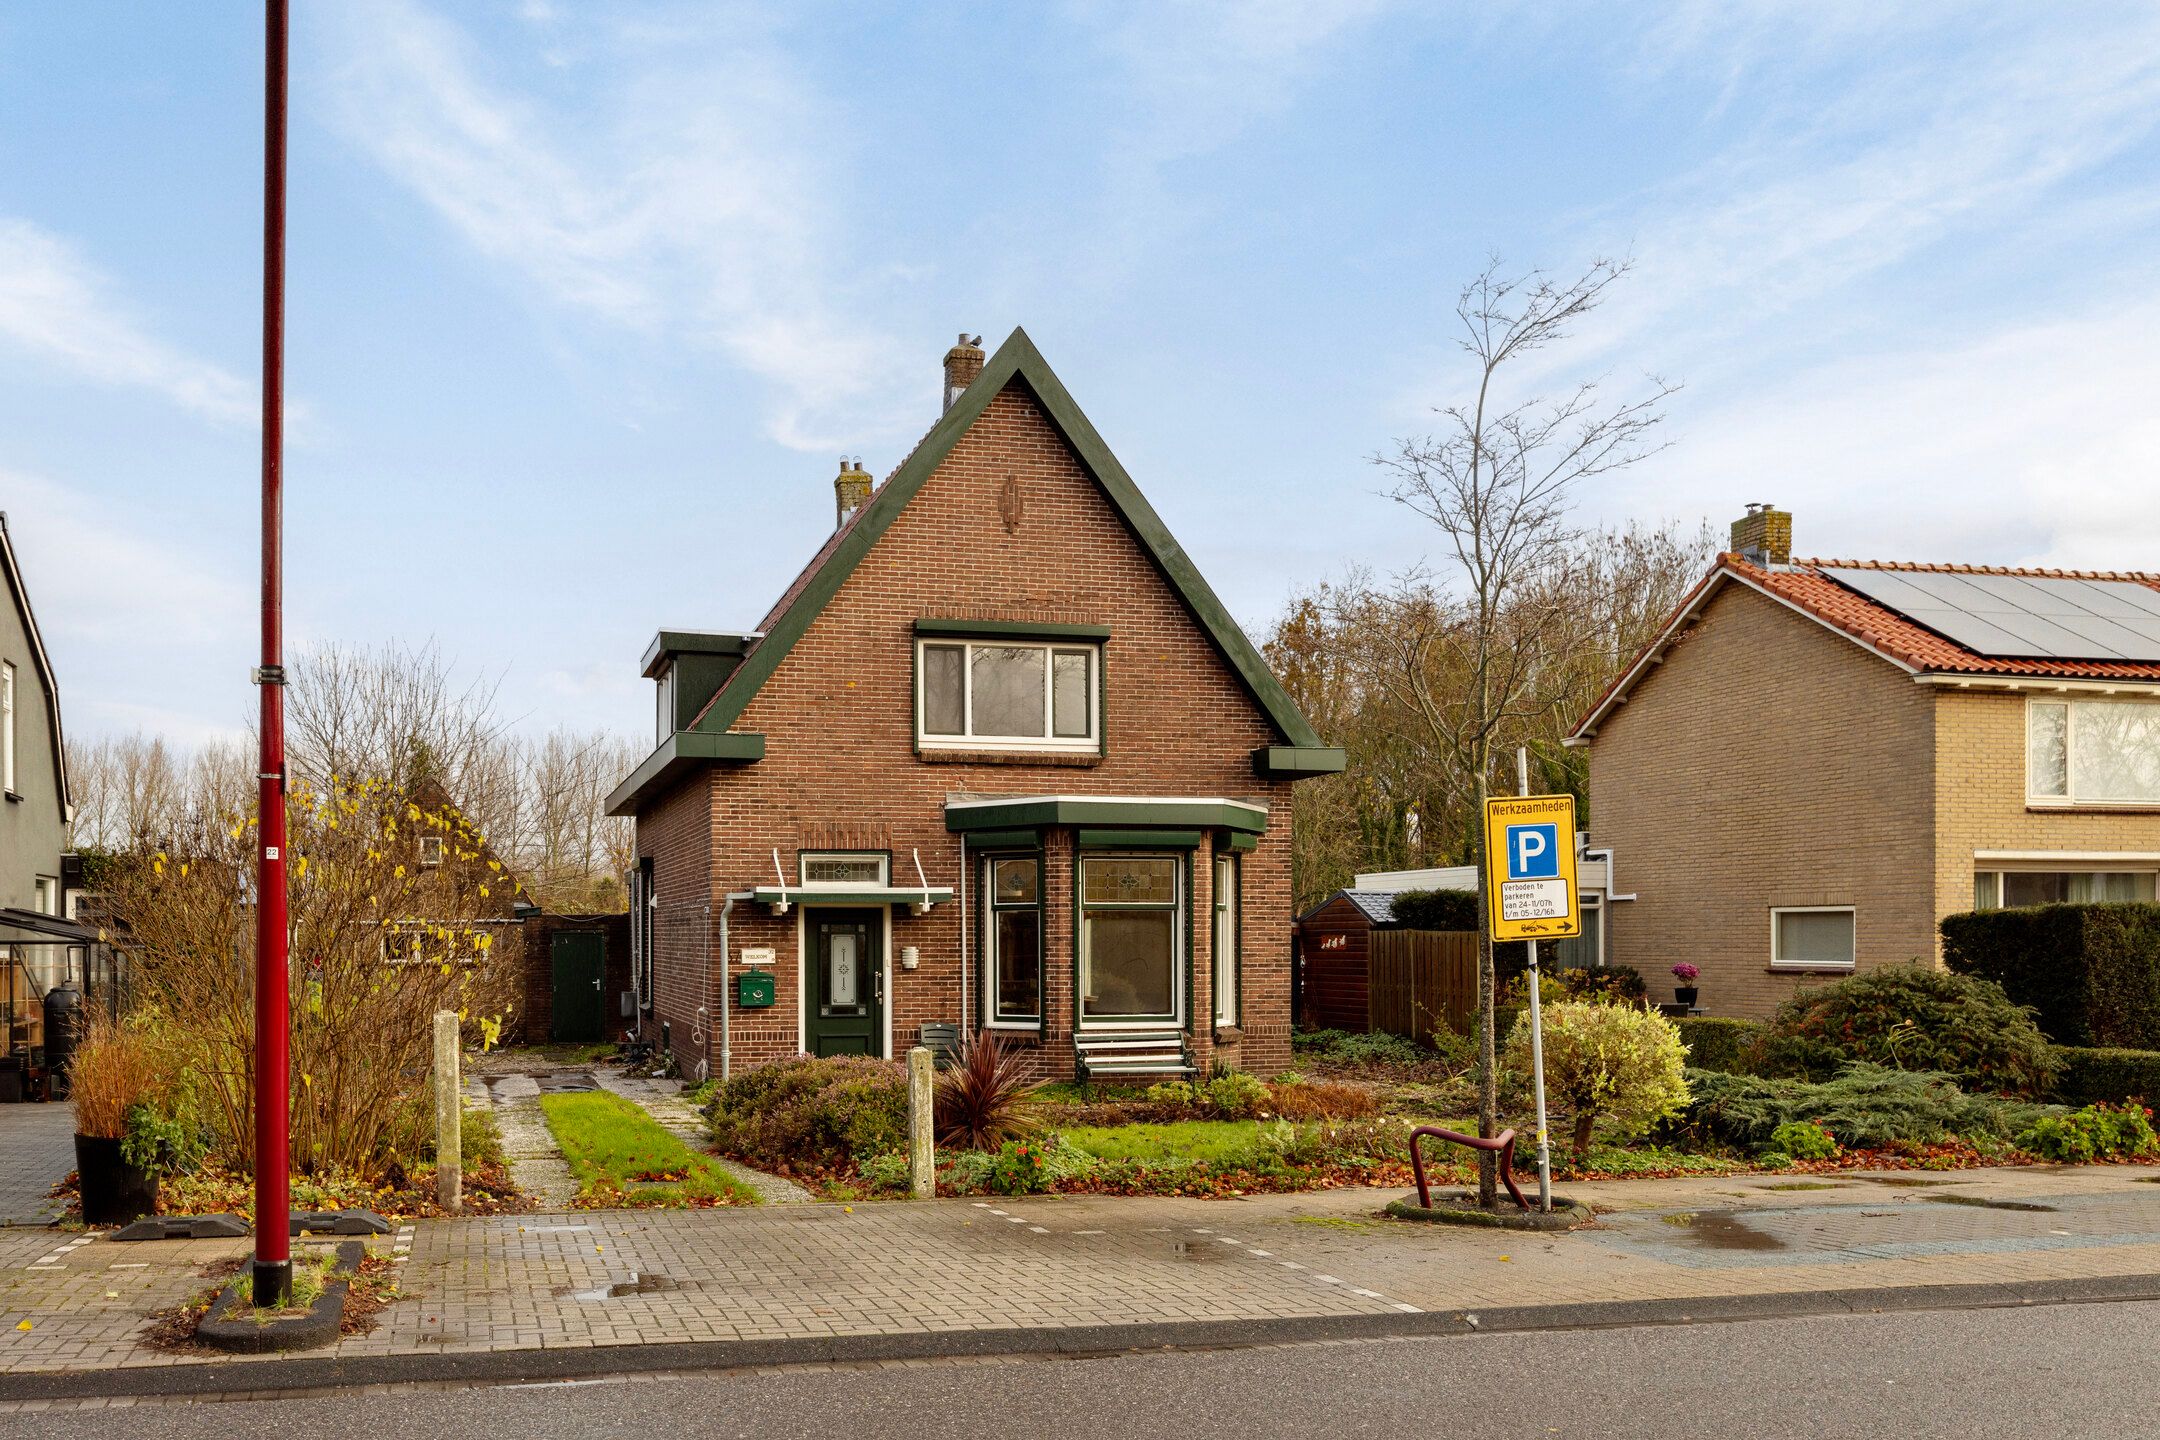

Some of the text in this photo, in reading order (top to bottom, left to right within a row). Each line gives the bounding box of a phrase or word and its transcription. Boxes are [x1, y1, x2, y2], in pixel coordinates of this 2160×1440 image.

[1492, 801, 1571, 816] Werkzaamheden
[1518, 831, 1546, 872] P
[1503, 882, 1544, 892] Verboden te
[1504, 892, 1535, 902] parkeren
[1518, 899, 1553, 908] 24-11/07h
[1505, 908, 1555, 918] t/m 05-12/16h
